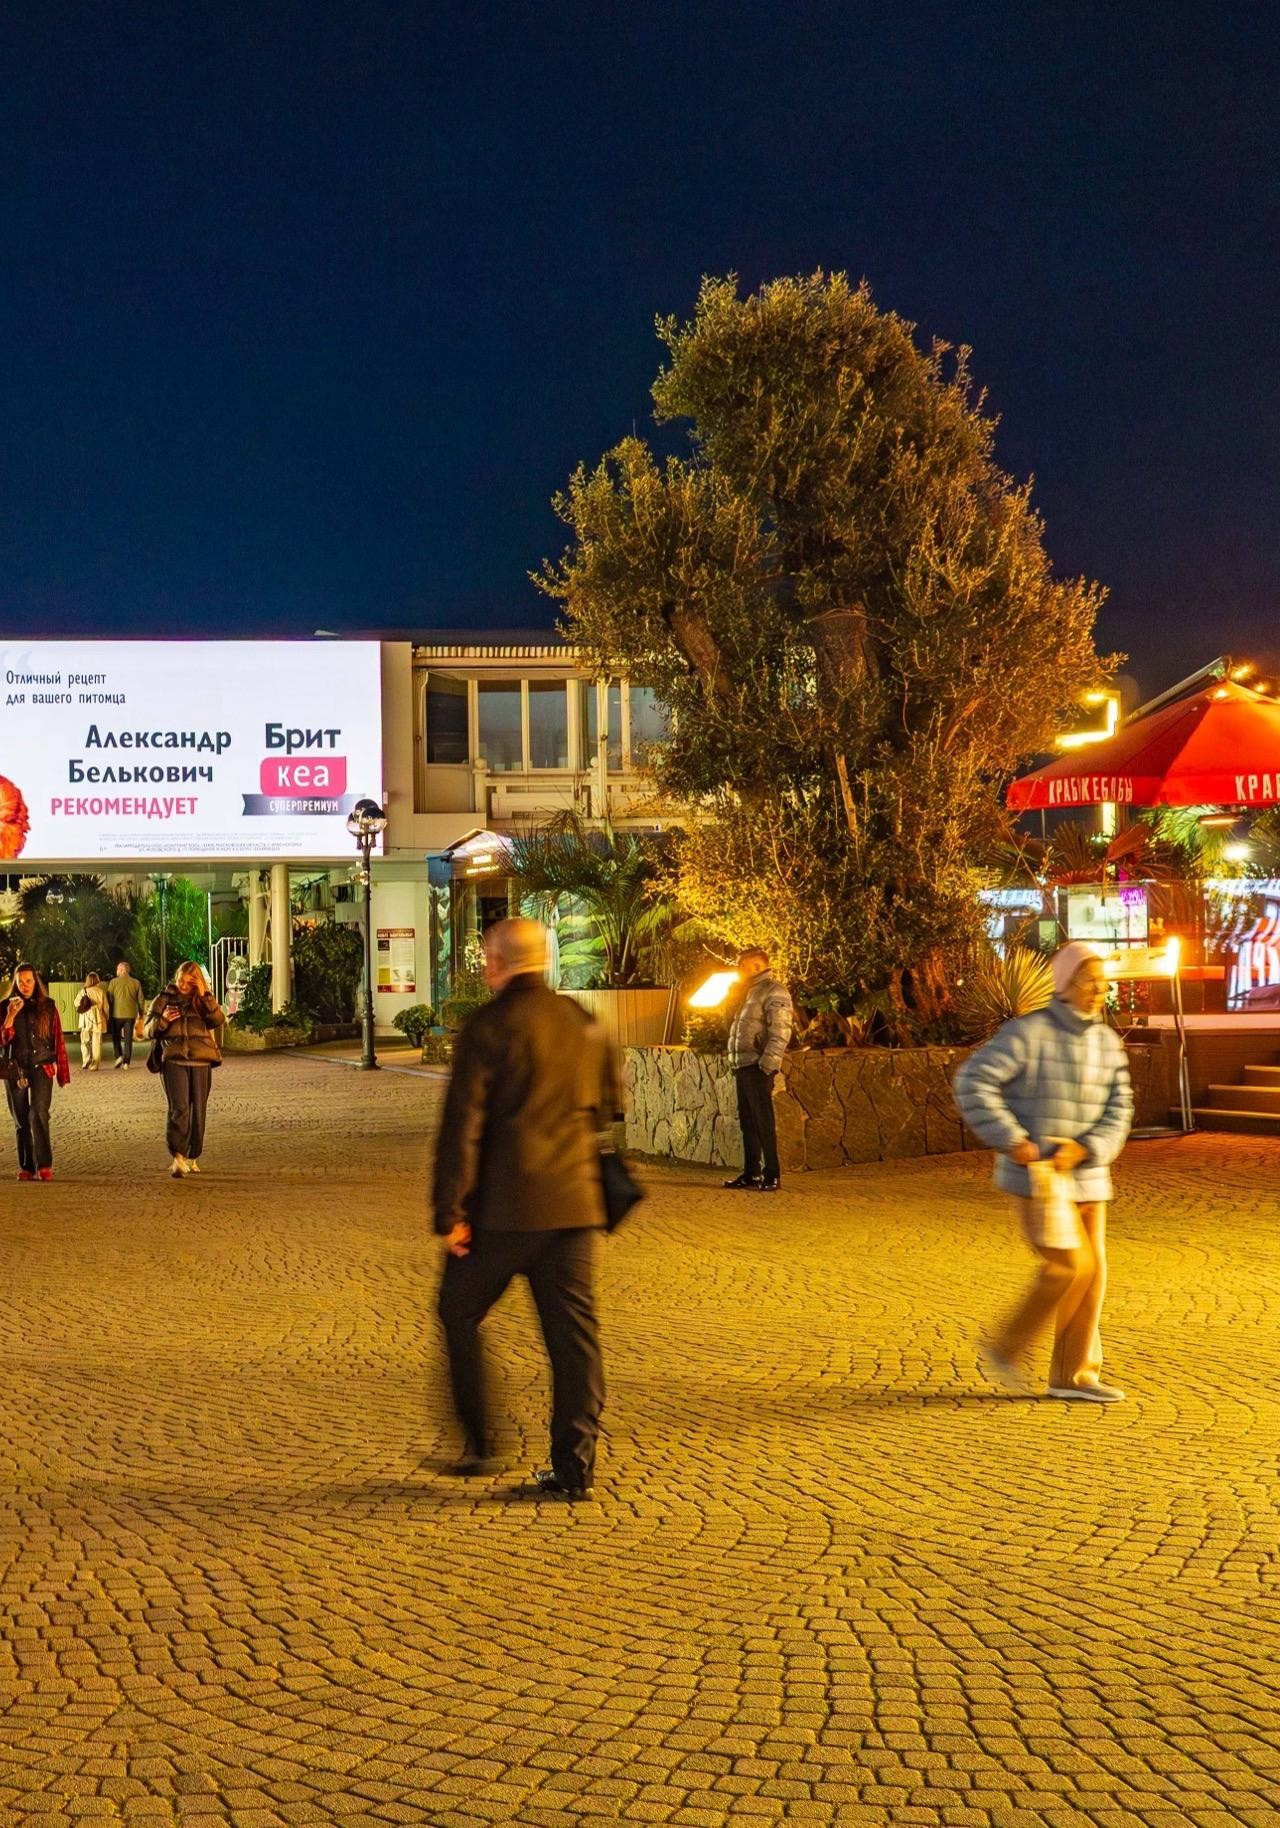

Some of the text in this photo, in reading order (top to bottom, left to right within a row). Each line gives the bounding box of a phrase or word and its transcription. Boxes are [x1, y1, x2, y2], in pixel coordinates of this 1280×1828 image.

[6, 670, 107, 688] Отличный рецепт
[6, 694, 126, 706] для вашего питомца
[85, 724, 232, 755] Александр
[265, 723, 341, 755] Брит
[69, 759, 214, 783] Белькович
[278, 765, 329, 787] кеа
[51, 797, 198, 819] РЕКОМЕНДУЕТ
[269, 799, 339, 812] СУПЕРПРЕМИУМ
